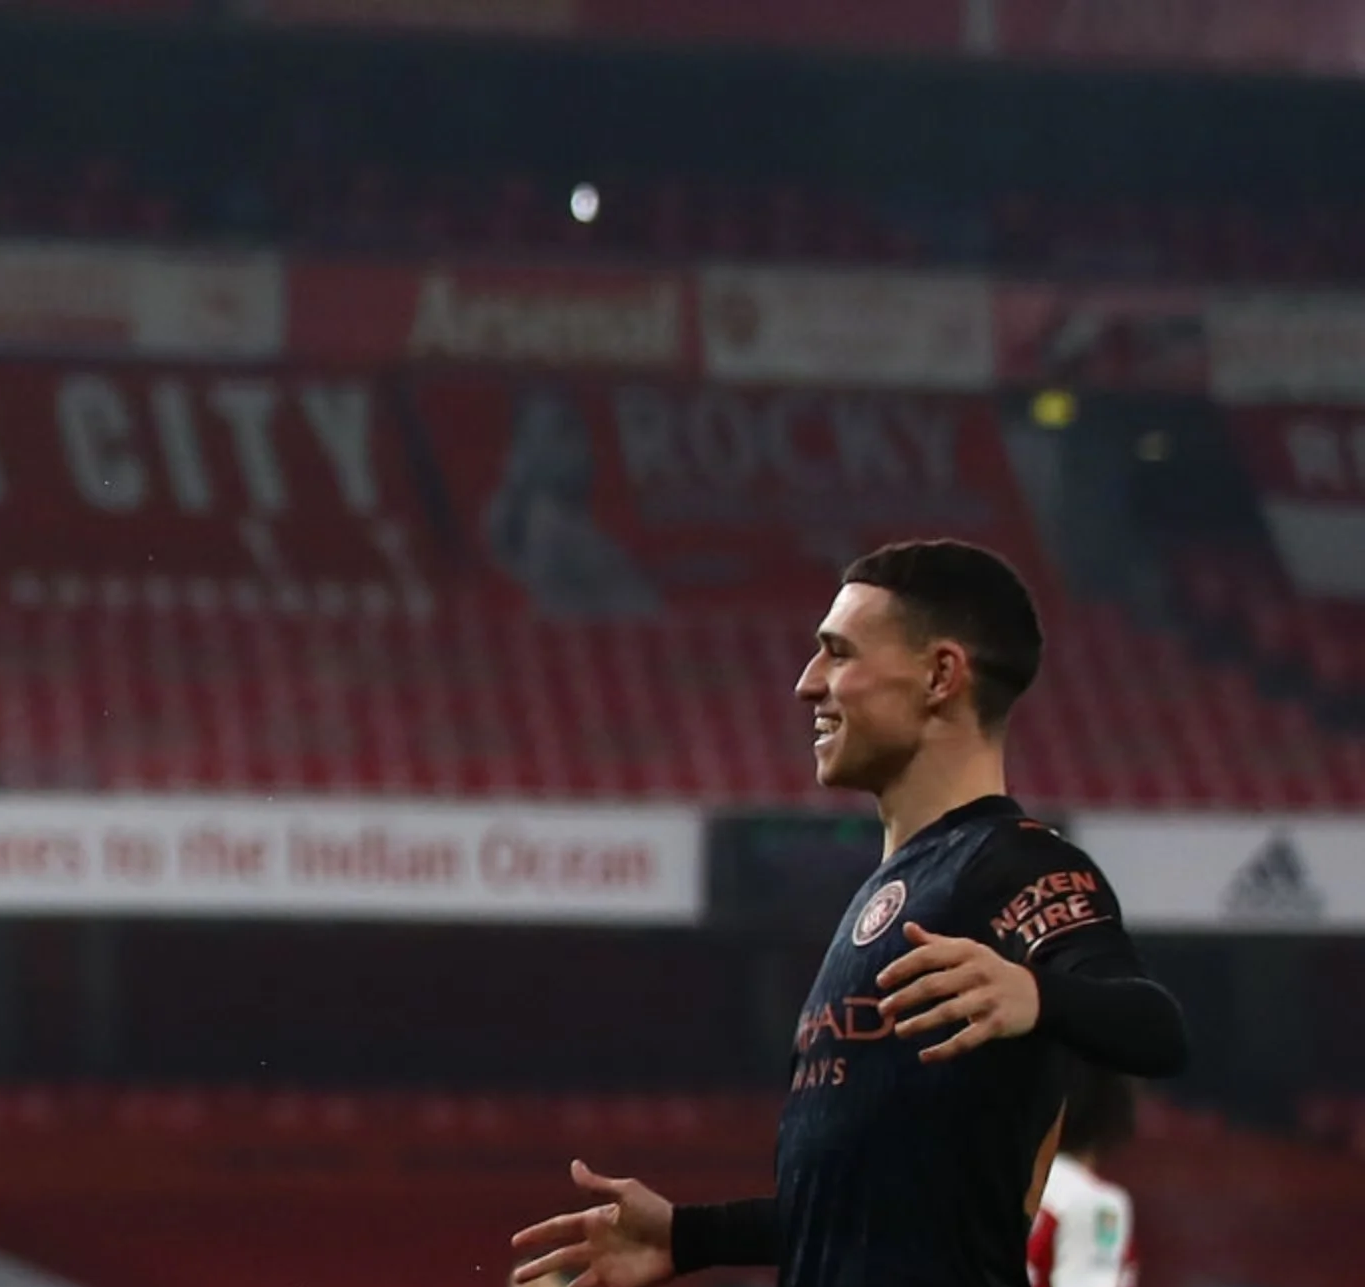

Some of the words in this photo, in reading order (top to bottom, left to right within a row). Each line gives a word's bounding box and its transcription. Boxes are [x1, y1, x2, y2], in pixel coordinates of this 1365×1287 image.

[407, 268, 682, 362] Arsenal
[55, 368, 377, 514] CITY
[612, 384, 959, 487] ROCKY
[990, 871, 1098, 940] NEXEN
[1016, 893, 1095, 943] TIRE
